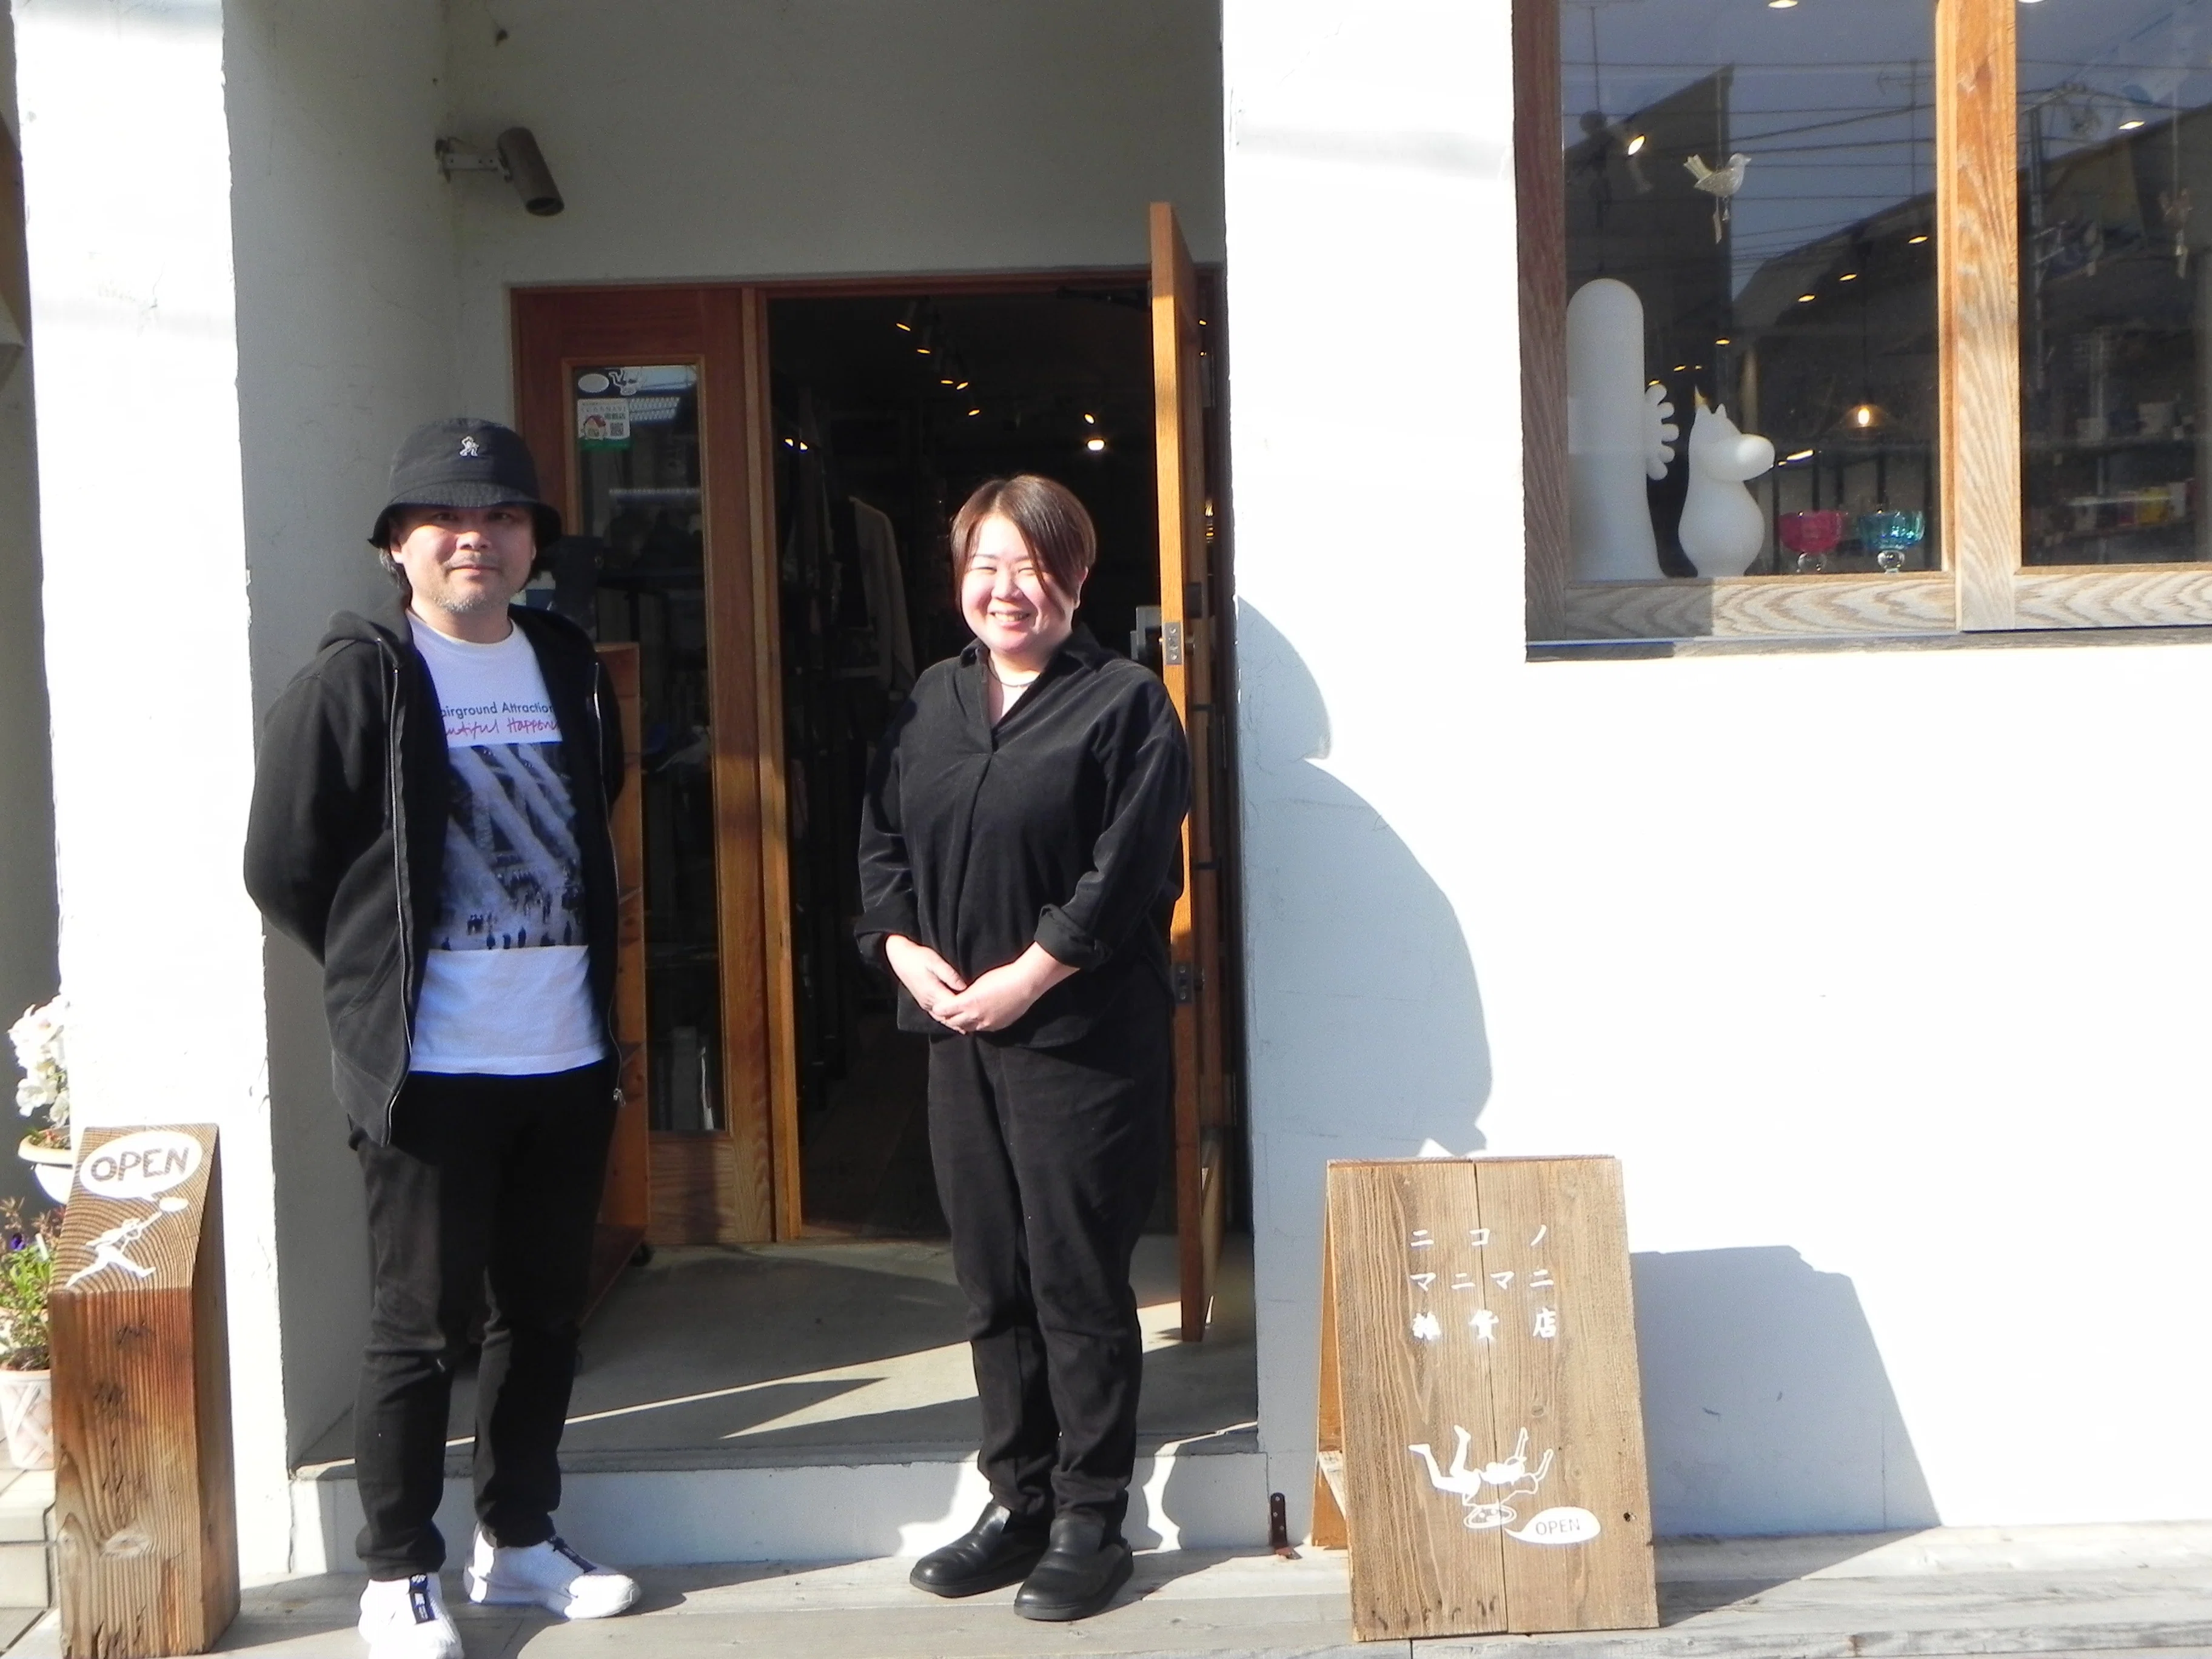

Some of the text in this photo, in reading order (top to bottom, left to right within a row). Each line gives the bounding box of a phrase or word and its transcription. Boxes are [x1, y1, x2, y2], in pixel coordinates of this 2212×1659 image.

[90, 1146, 190, 1182] OPEN
[1409, 1269, 1554, 1292] マニマニ
[1535, 1518, 1581, 1535] OPEN
